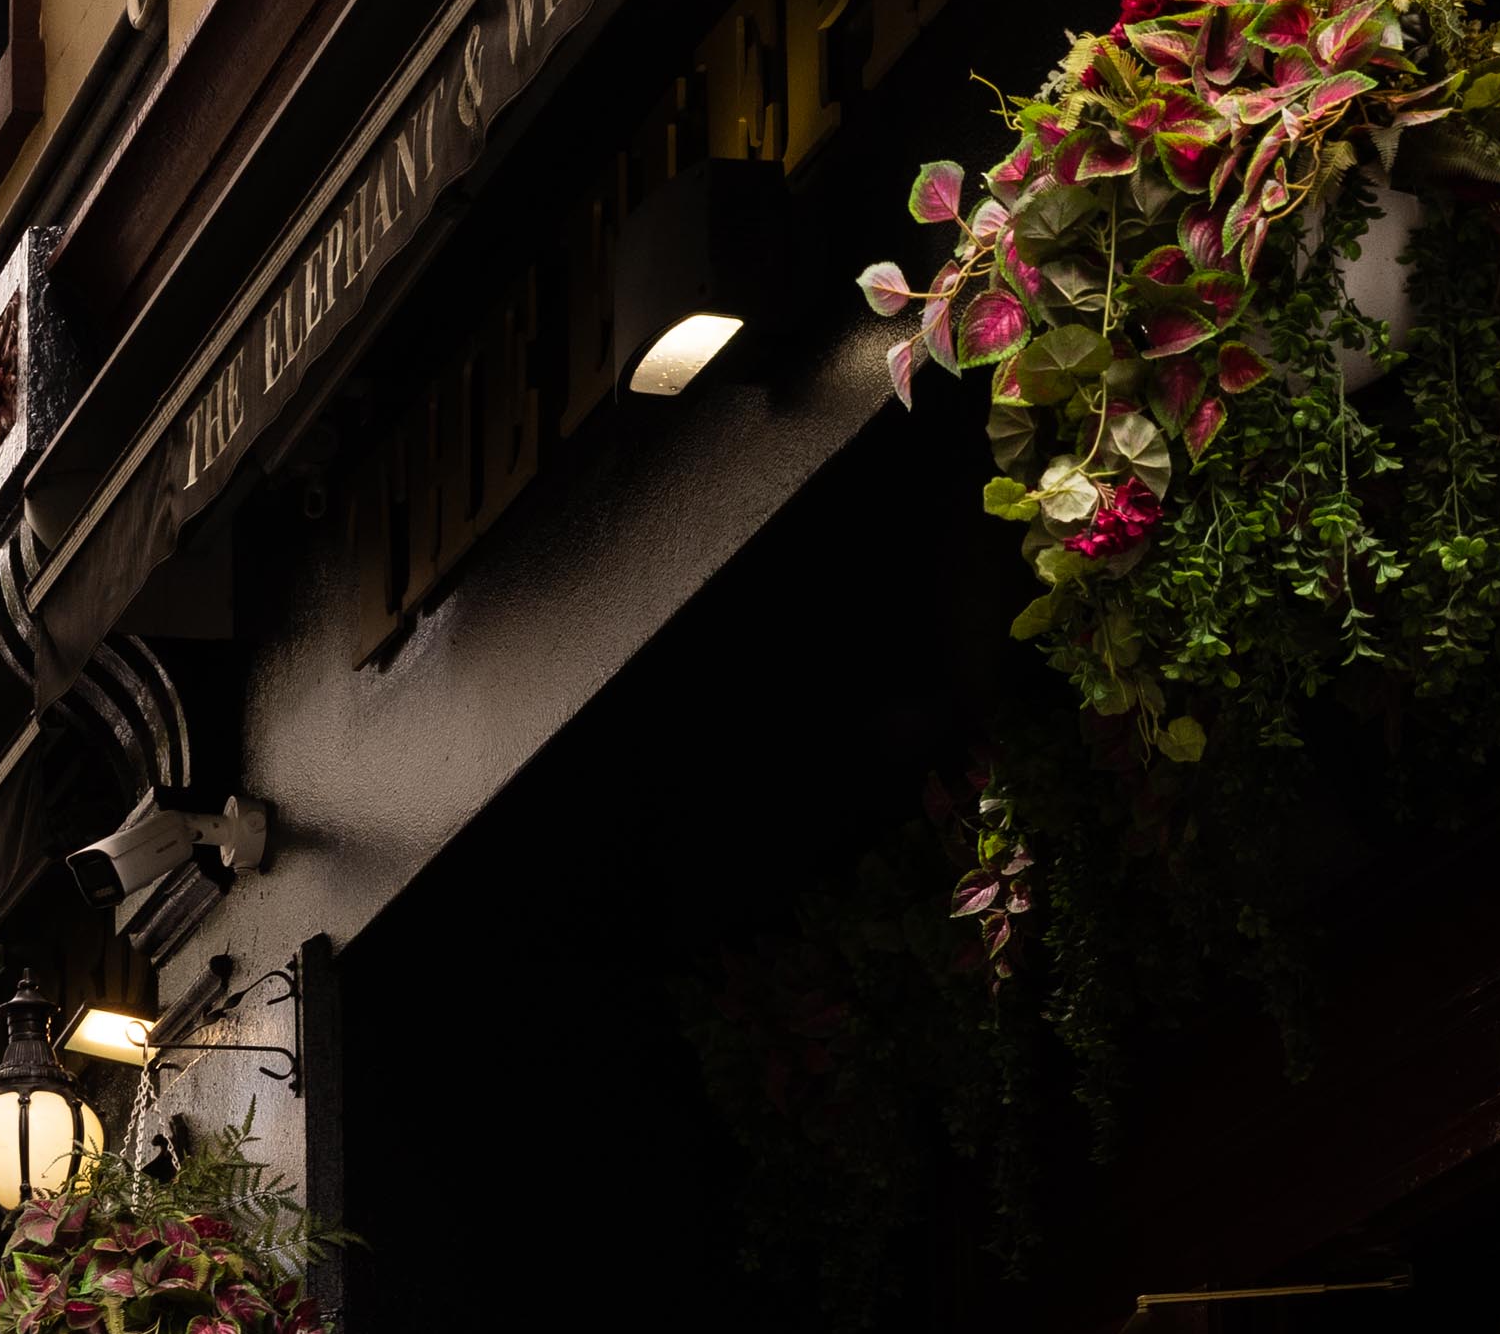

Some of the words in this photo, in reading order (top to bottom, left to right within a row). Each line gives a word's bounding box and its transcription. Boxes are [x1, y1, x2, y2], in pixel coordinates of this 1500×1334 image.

[184, 365, 246, 490] THE
[261, 77, 446, 396] ELEPHANT
[458, 23, 487, 129] &
